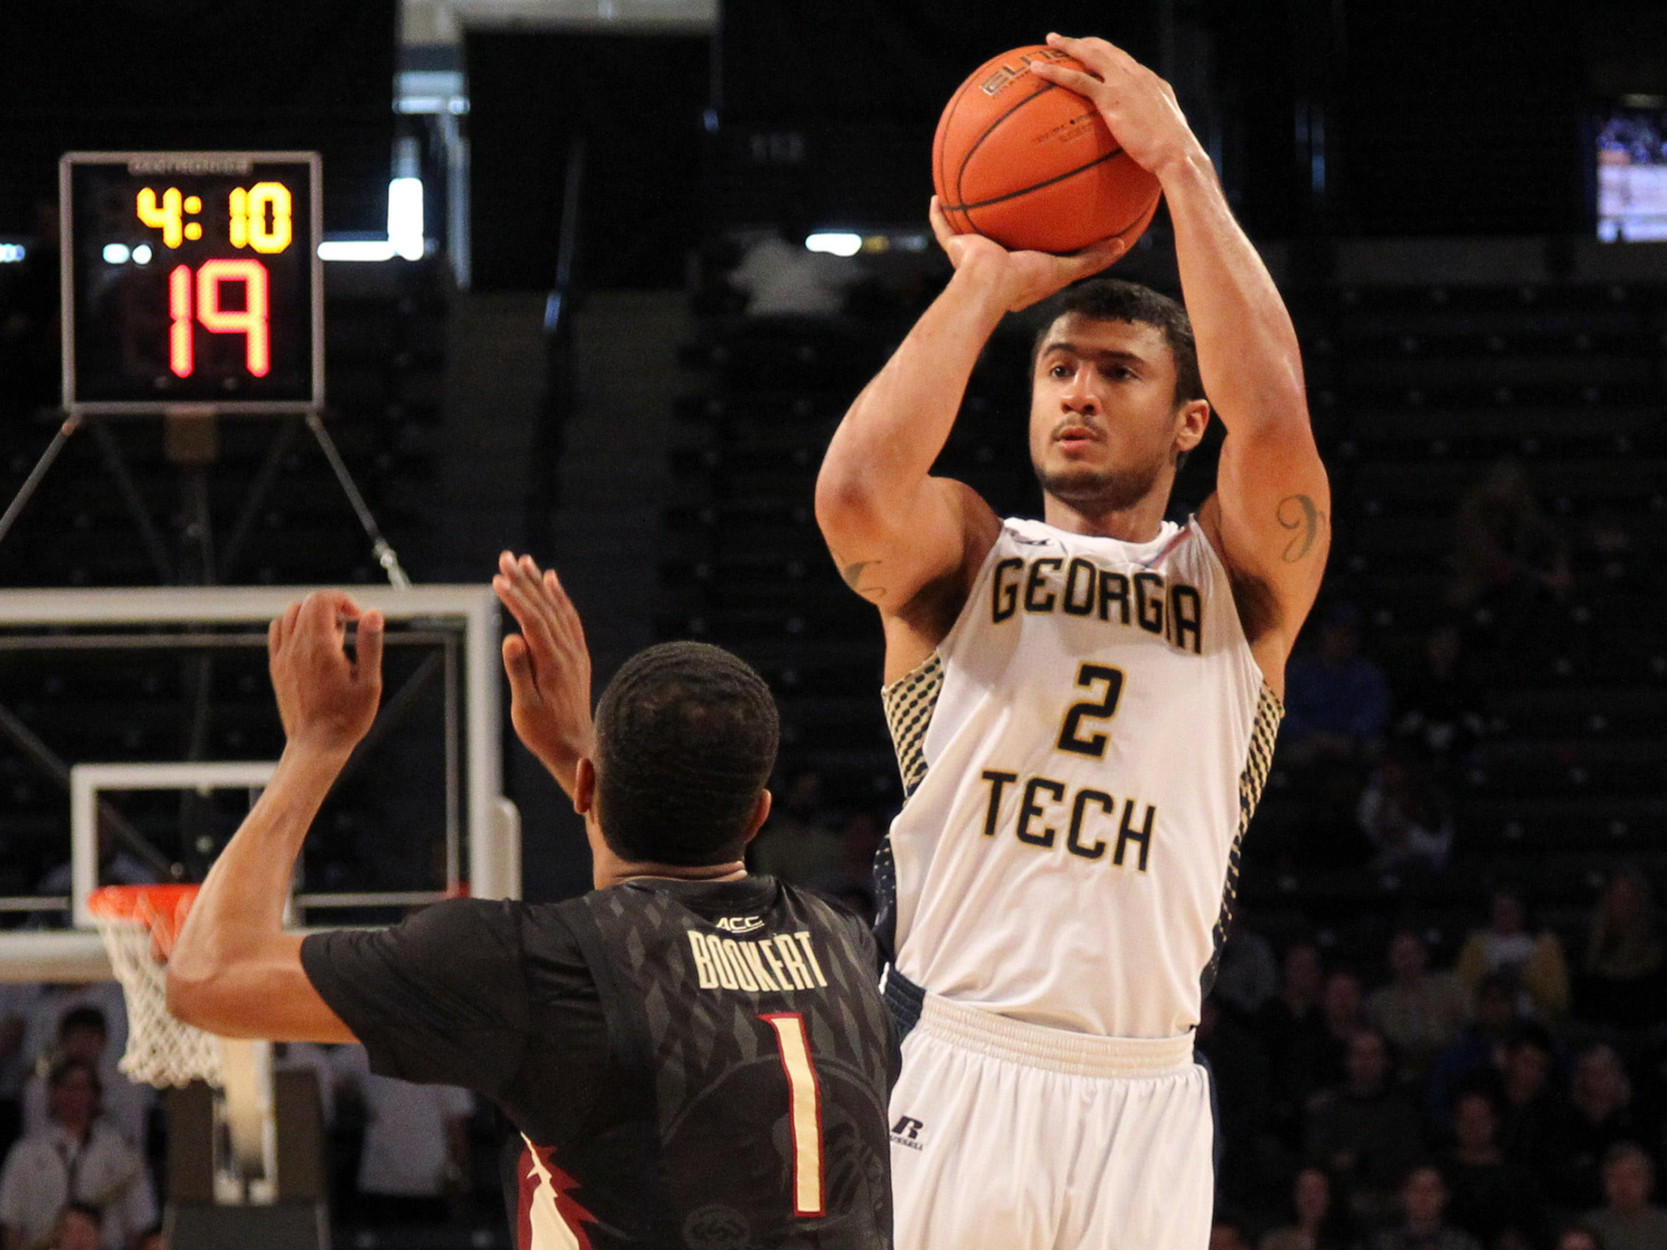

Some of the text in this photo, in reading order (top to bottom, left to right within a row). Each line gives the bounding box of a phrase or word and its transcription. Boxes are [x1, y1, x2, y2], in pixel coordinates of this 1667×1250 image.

[169, 258, 271, 379] 19
[1053, 659, 1127, 762] 2
[980, 769, 1159, 873] TECH
[687, 930, 828, 992] BOOKERT
[715, 915, 765, 933] ACC
[756, 1012, 825, 1217] 1
